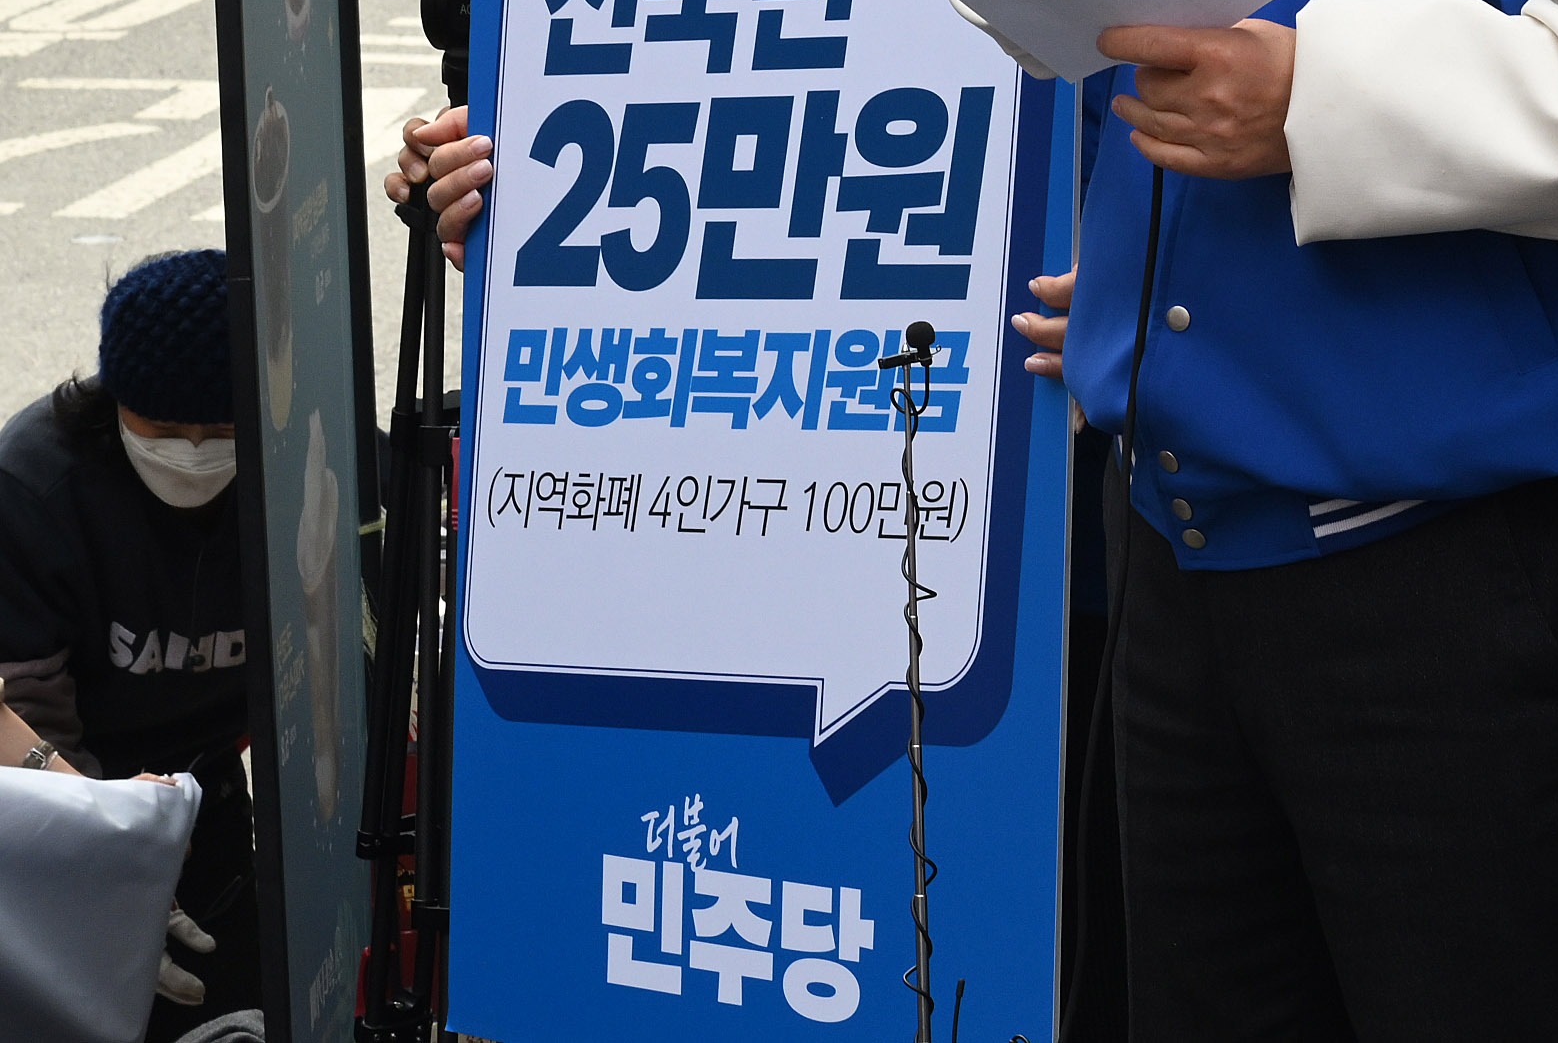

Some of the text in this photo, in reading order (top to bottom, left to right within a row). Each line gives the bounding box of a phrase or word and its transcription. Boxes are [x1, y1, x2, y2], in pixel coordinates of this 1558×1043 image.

[513, 85, 996, 301] 25만원
[501, 325, 971, 434] 민생회복지원금
[487, 465, 970, 543] (지역화폐 4인가구 100만원)
[640, 793, 739, 873] 더불어
[600, 853, 875, 1024] 민주당
